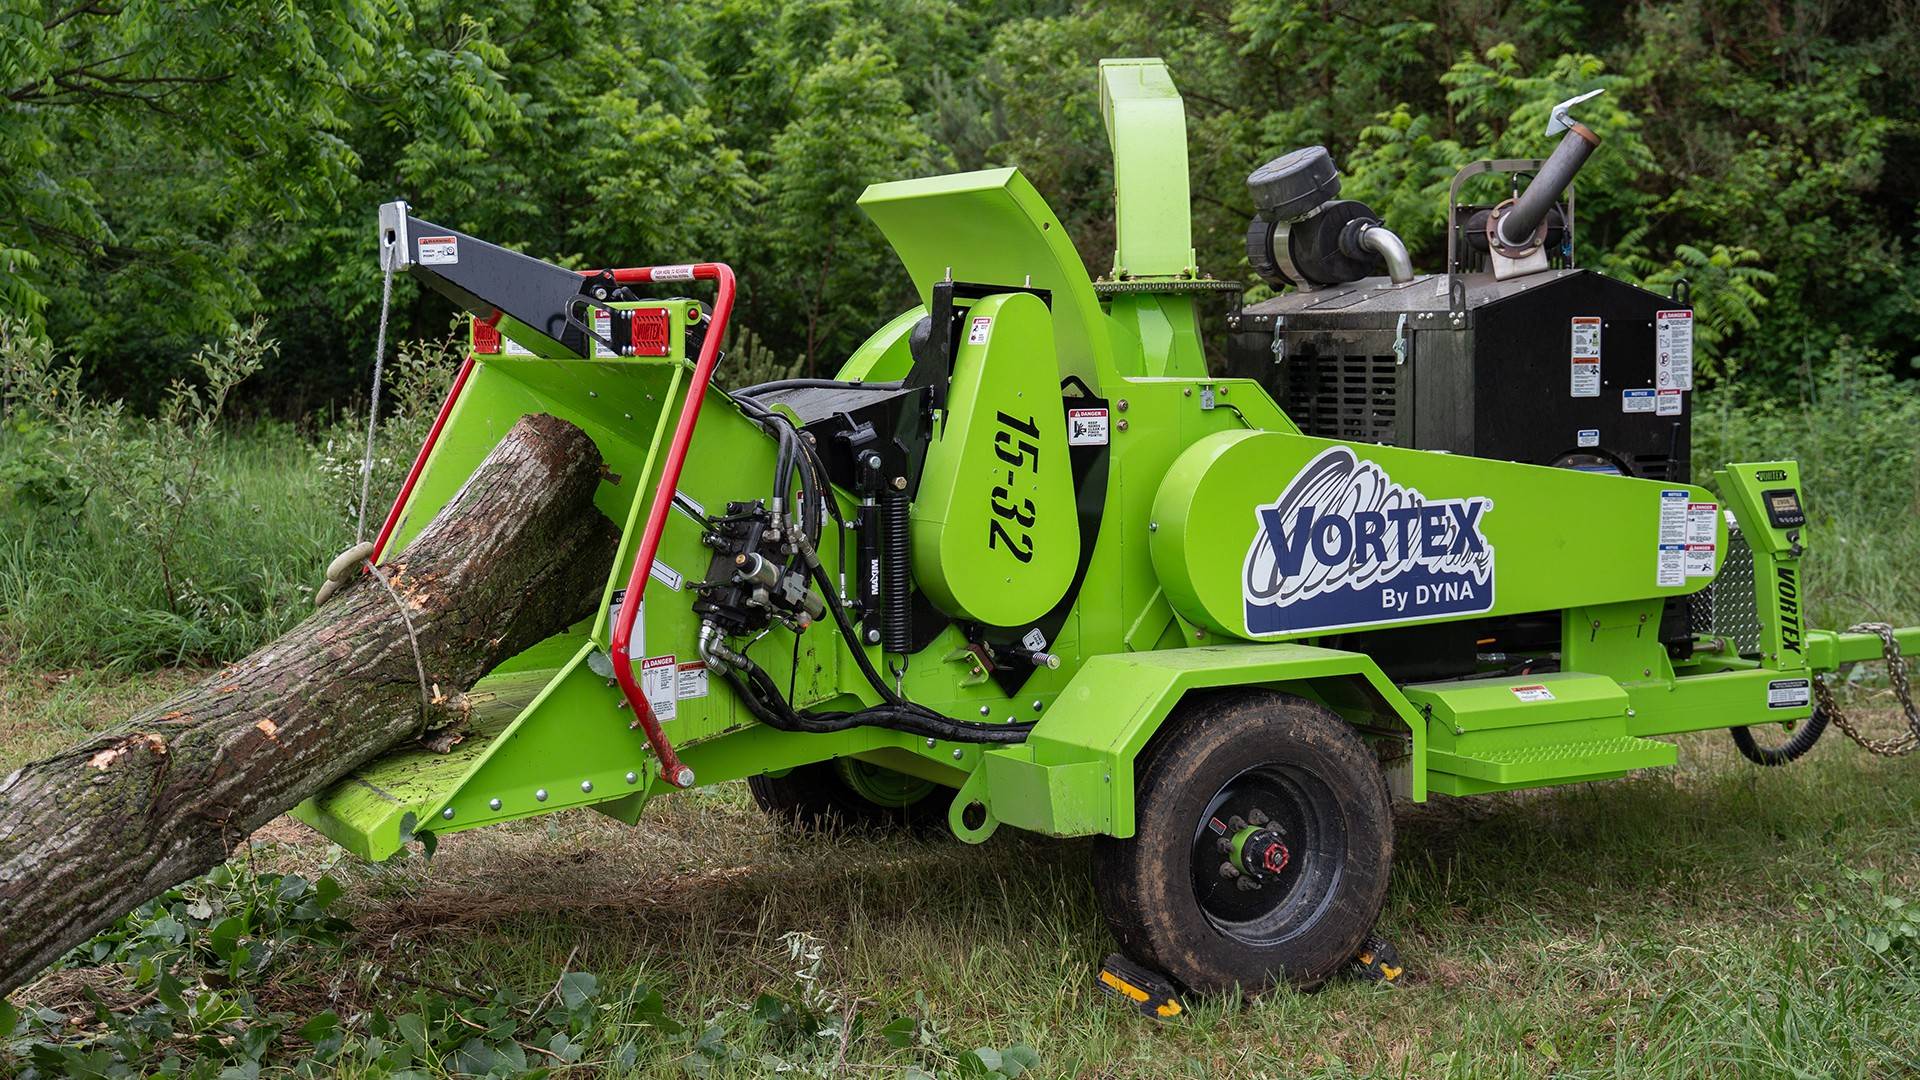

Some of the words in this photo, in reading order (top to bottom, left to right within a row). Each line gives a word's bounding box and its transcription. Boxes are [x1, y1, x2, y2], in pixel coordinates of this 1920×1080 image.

[637, 323, 662, 340] VORTEX
[988, 410, 1040, 564] 15-32
[1261, 501, 1484, 577] VORTEX
[870, 559, 879, 595] MAXIM
[1382, 588, 1408, 612] By
[1415, 581, 1474, 606] DYNA
[1777, 567, 1801, 655] VORTEX
[650, 657, 673, 667] DANGER
